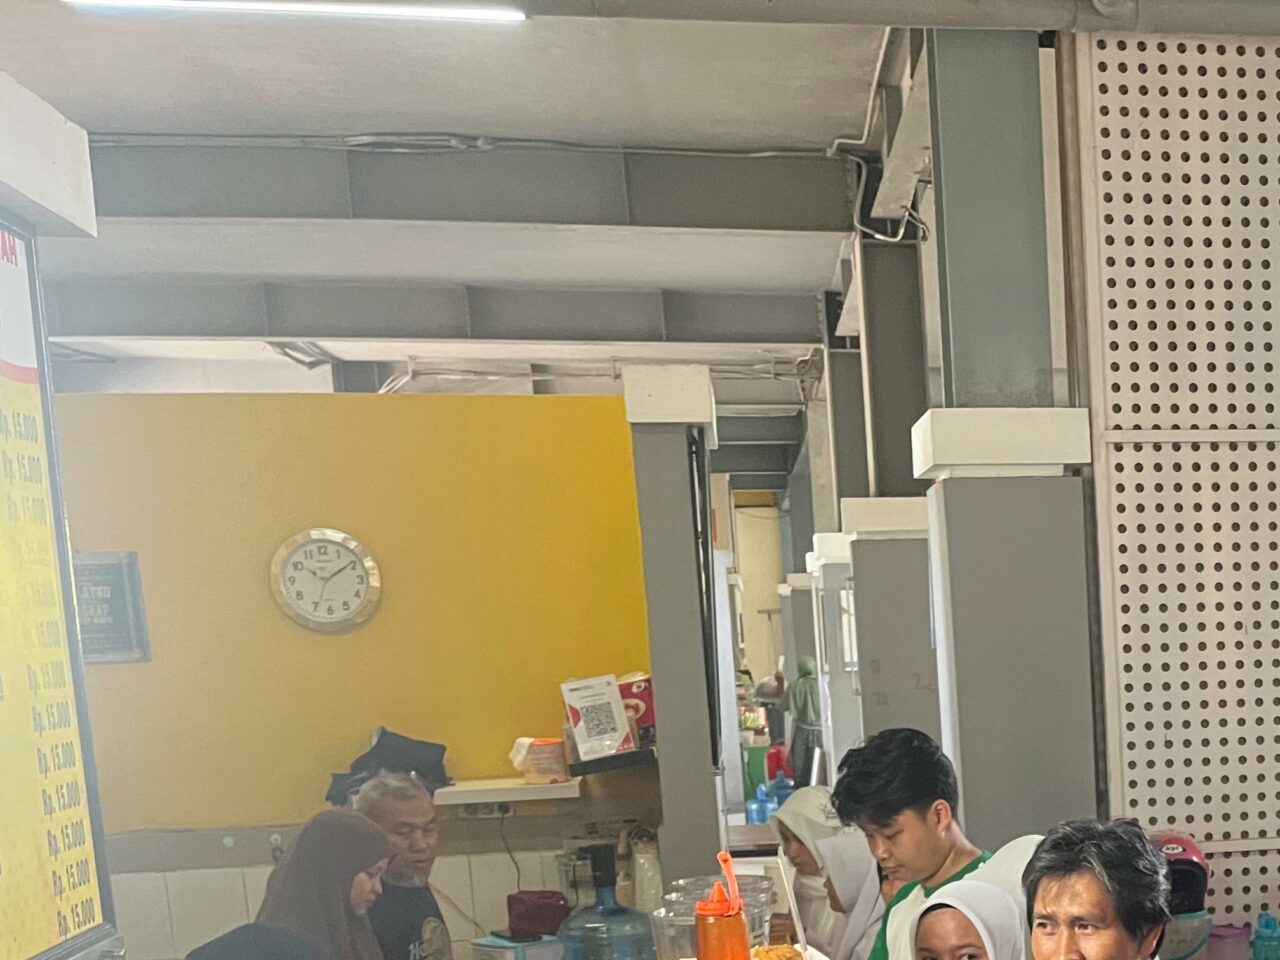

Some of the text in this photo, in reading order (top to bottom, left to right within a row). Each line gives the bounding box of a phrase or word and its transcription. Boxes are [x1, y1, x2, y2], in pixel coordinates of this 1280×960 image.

[304, 549, 313, 560] 11
[317, 545, 328, 555] 12
[336, 549, 341, 559] 1
[292, 561, 303, 571] 10
[288, 576, 296, 585] 9
[356, 574, 364, 585] 3
[296, 591, 303, 600] 8
[354, 590, 361, 599] 4
[312, 602, 318, 612] 7
[327, 606, 334, 615] 6
[342, 601, 350, 611] 5
[32, 701, 71, 738] Rp. 15.000
[37, 741, 76, 780] Rp. 15.000
[42, 780, 81, 820] Rp. 15.000
[47, 819, 86, 861] Rp. 15.000
[52, 858, 90, 901] Rp. 15.000
[57, 897, 96, 939] Rp. 15.000
